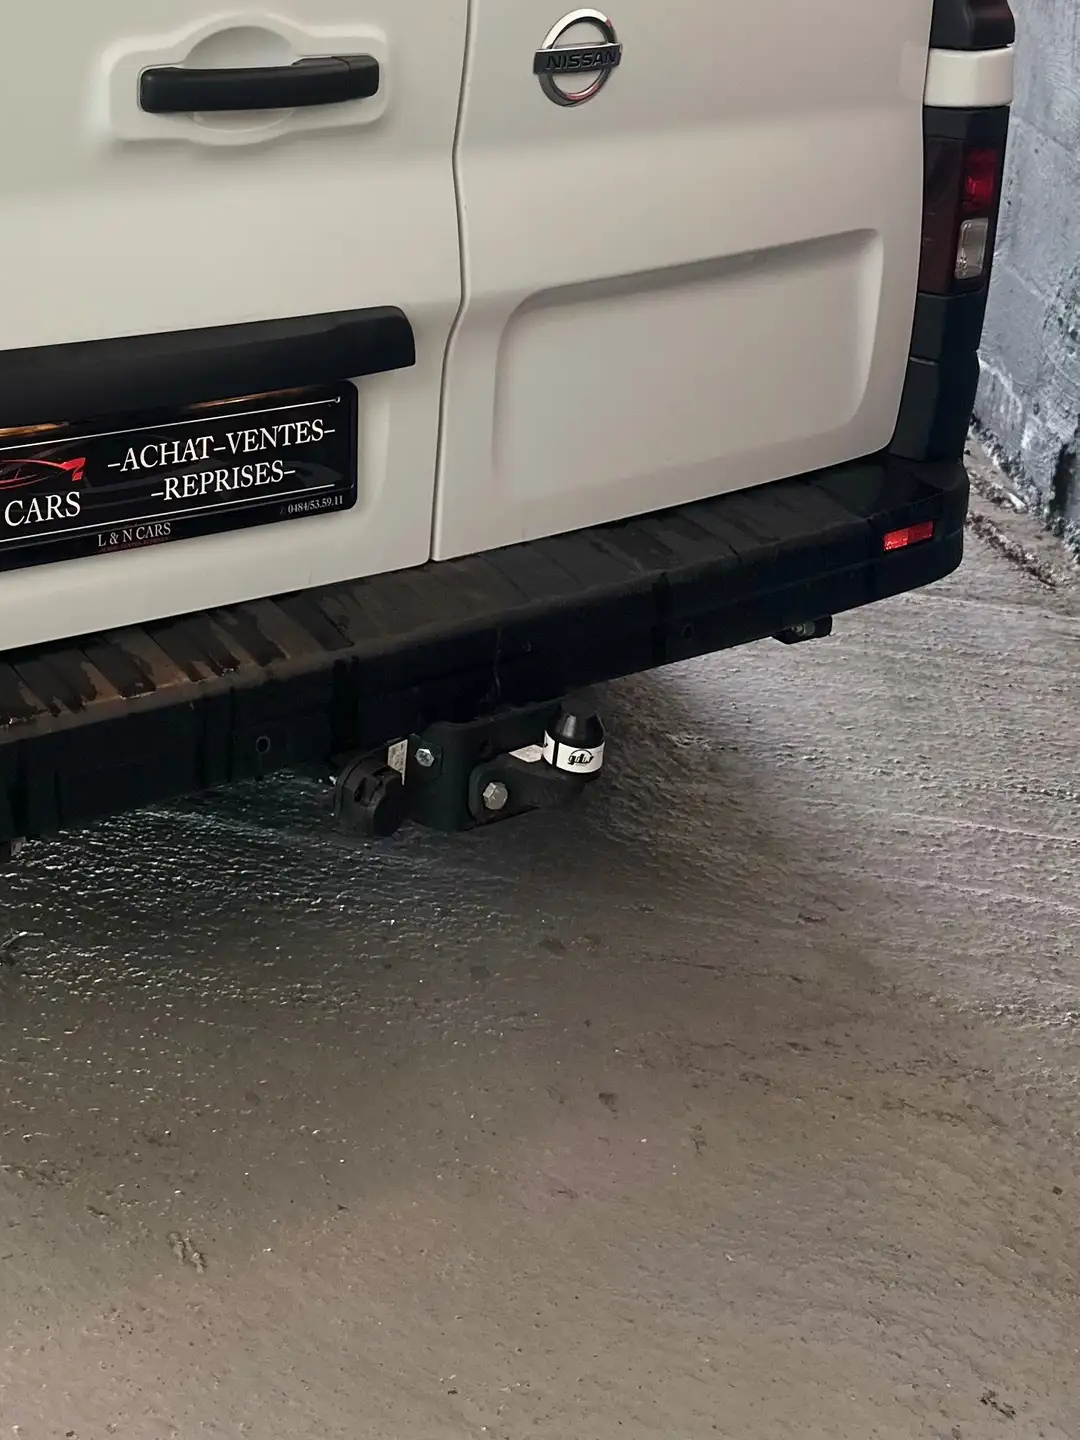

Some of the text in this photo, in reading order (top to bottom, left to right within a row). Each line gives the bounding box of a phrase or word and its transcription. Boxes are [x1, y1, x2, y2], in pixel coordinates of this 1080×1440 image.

[546, 51, 617, 69] NISSAN
[4, 491, 82, 527] CARS
[287, 494, 344, 514] 0484/53.59.11
[97, 533, 107, 547] L
[109, 531, 119, 545] &
[122, 528, 133, 543] N
[135, 521, 171, 540] CARS
